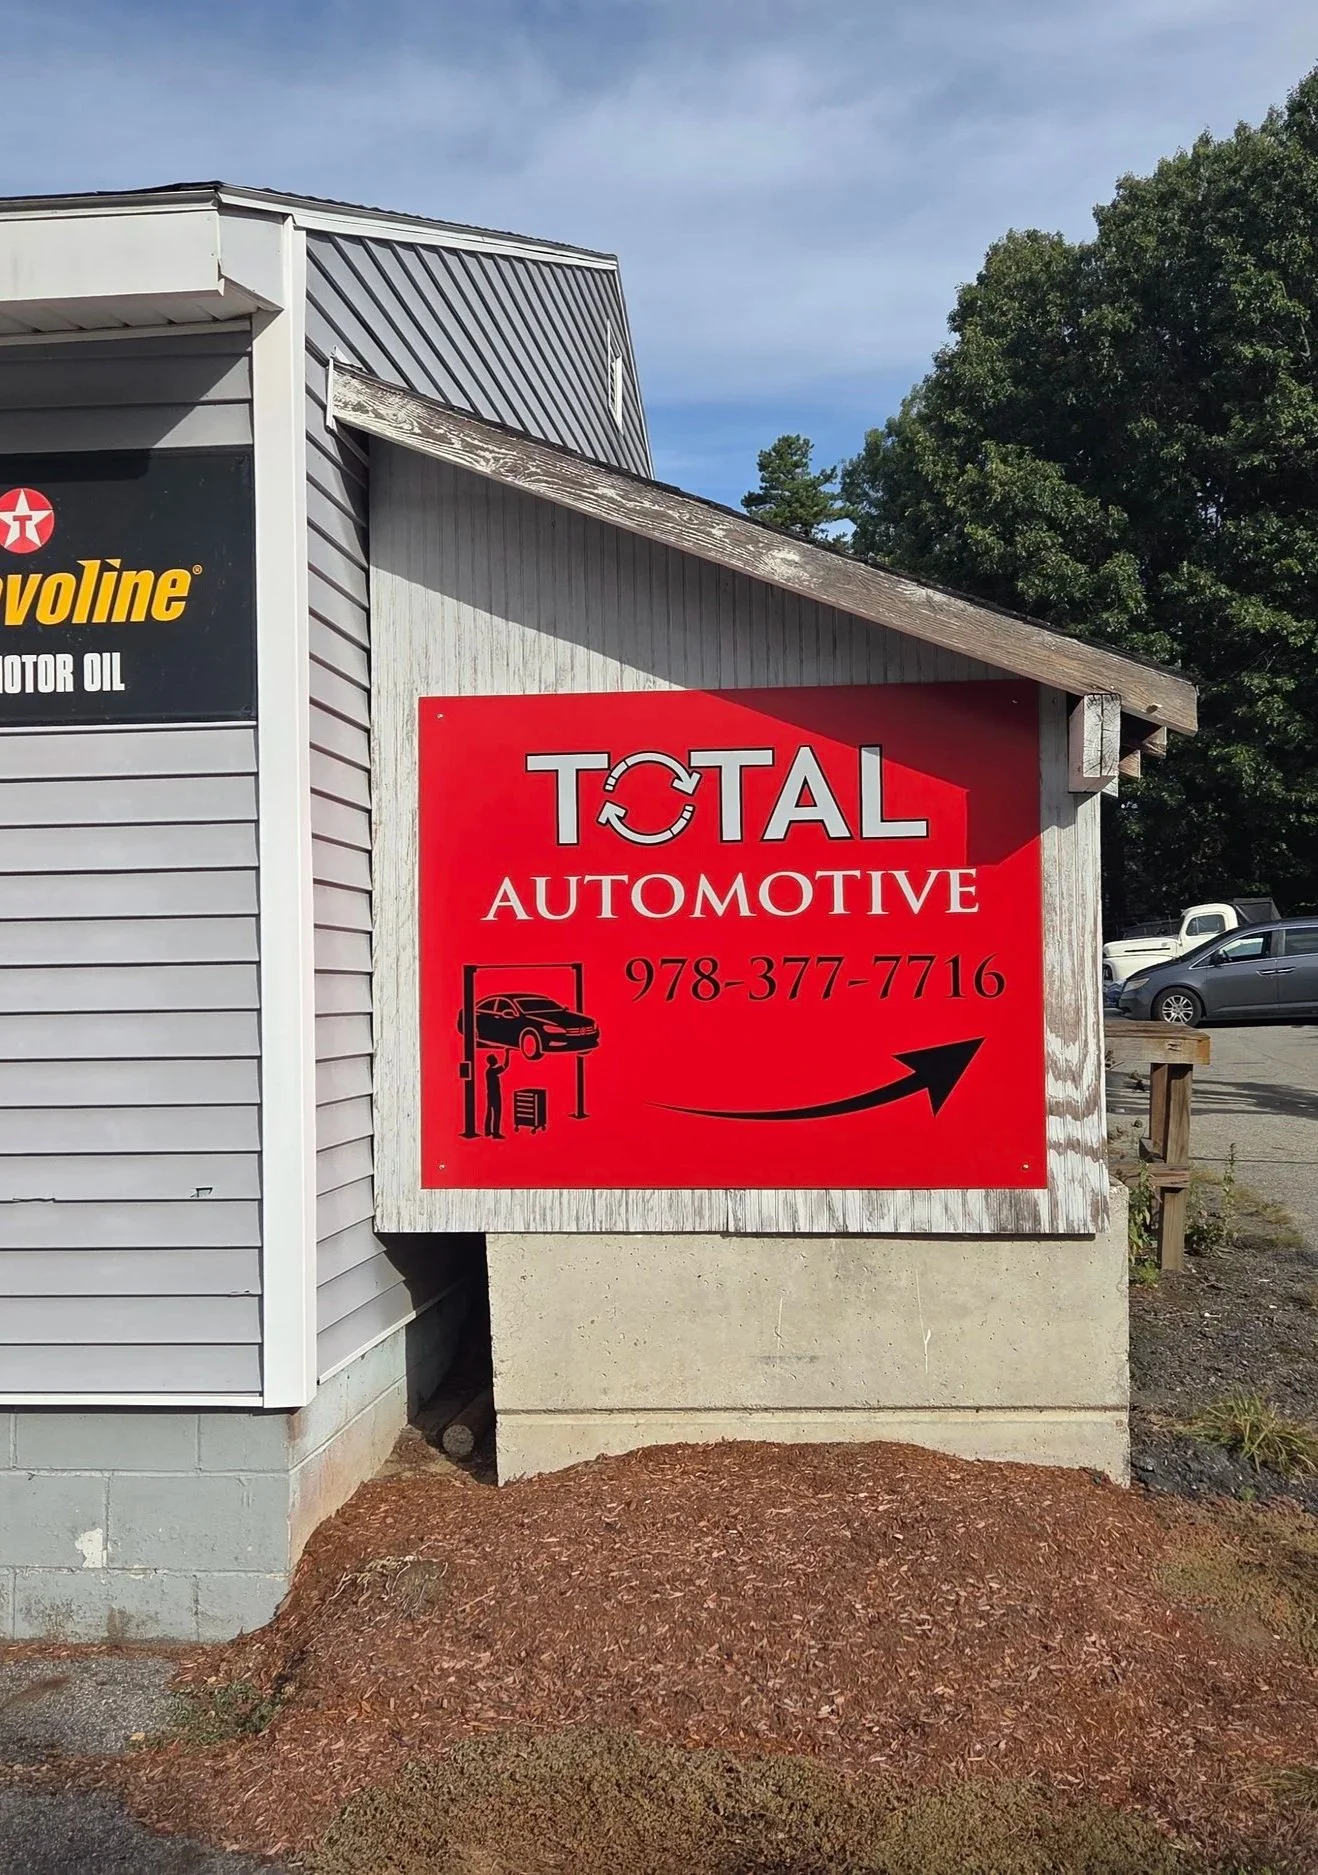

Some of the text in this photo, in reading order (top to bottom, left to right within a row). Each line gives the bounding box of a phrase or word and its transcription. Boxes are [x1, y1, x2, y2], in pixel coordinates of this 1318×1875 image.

[0, 652, 125, 694] OTOR OIL
[526, 744, 930, 846] TOTAL
[481, 867, 980, 921] AUTOMOTIVE
[625, 954, 1006, 1002] 978-377-7716
